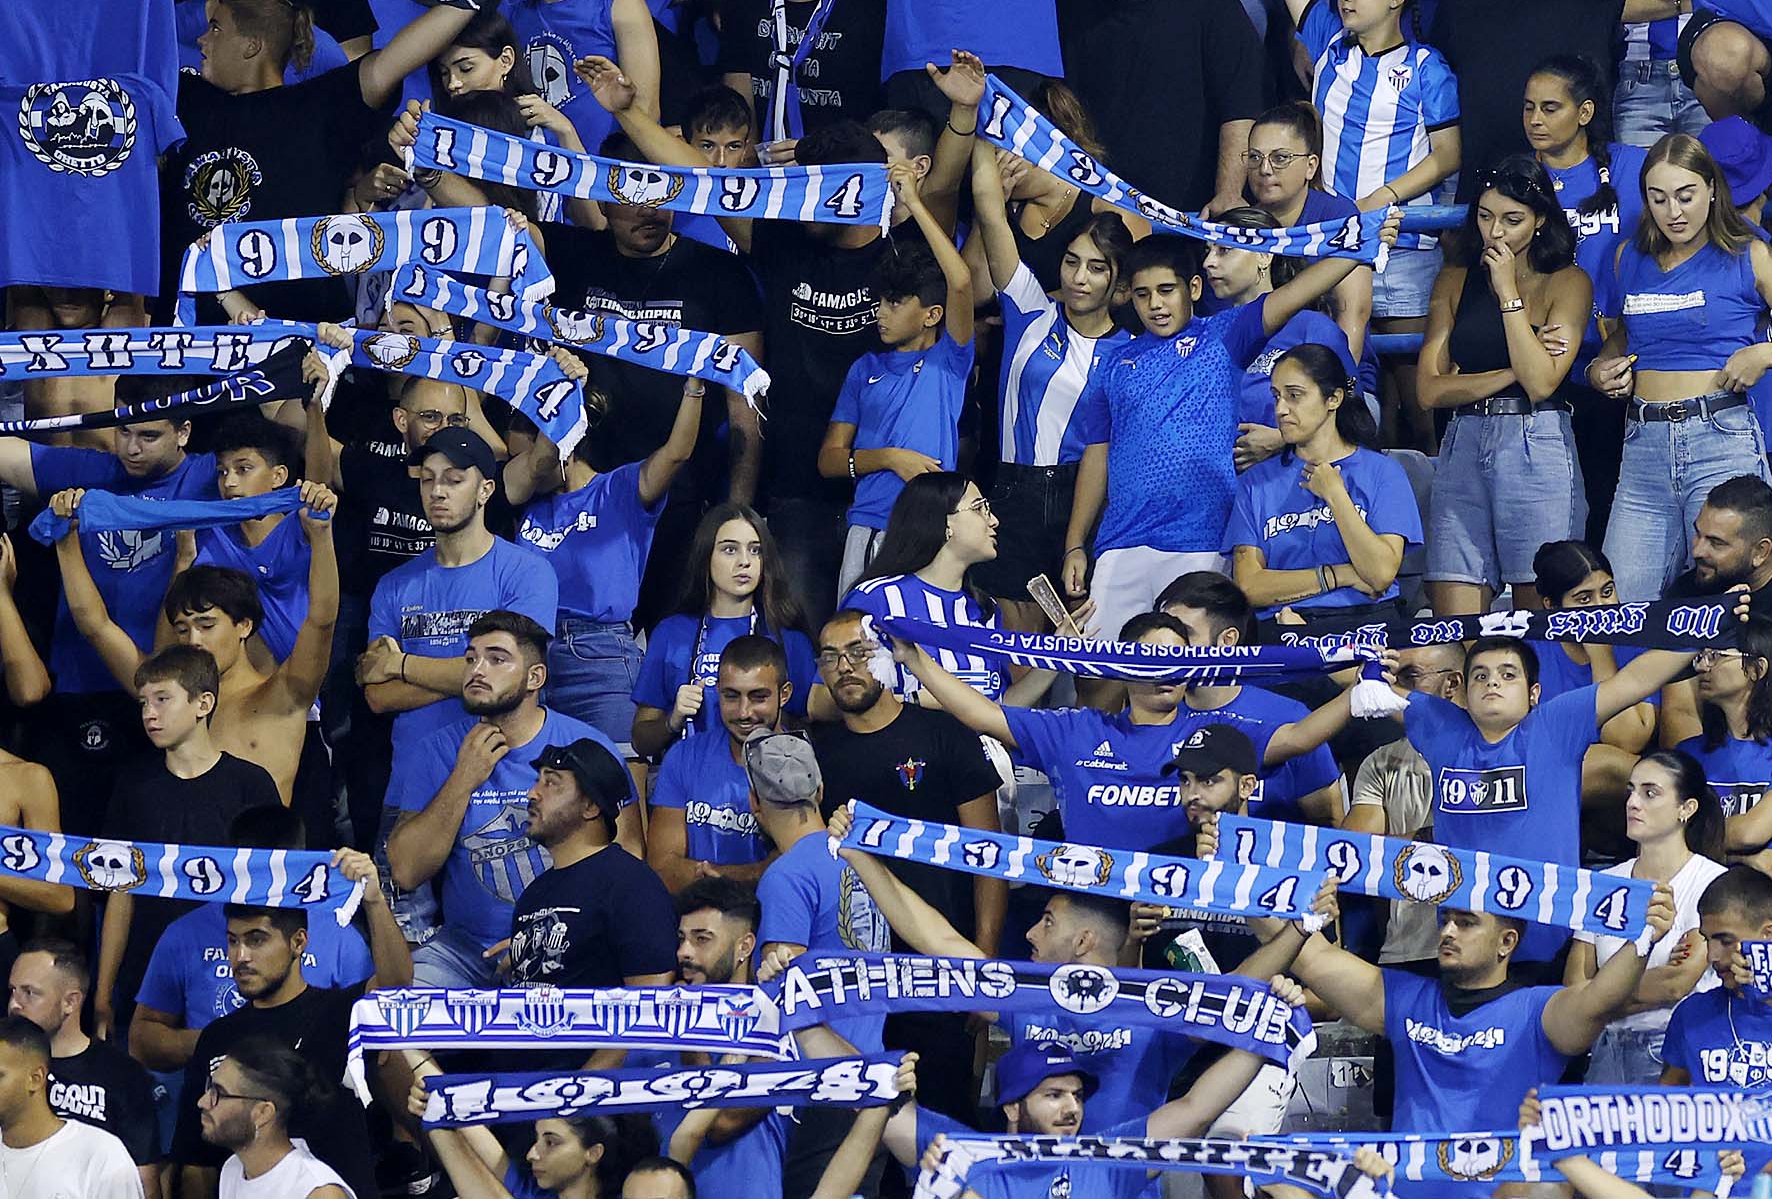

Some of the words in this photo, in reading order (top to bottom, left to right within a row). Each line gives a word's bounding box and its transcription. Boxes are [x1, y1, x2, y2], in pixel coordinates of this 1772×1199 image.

[989, 632, 1015, 647] FC
[1019, 633, 1137, 657] FAMAGUSTA
[1086, 784, 1183, 808] FONBET
[1441, 778, 1467, 805] 19
[1490, 776, 1518, 805] 11
[785, 957, 1017, 1016] ATHENS
[1144, 977, 1293, 1045] CLUB
[1699, 1048, 1728, 1083] 19
[1542, 1092, 1747, 1151] ORTHODOX
